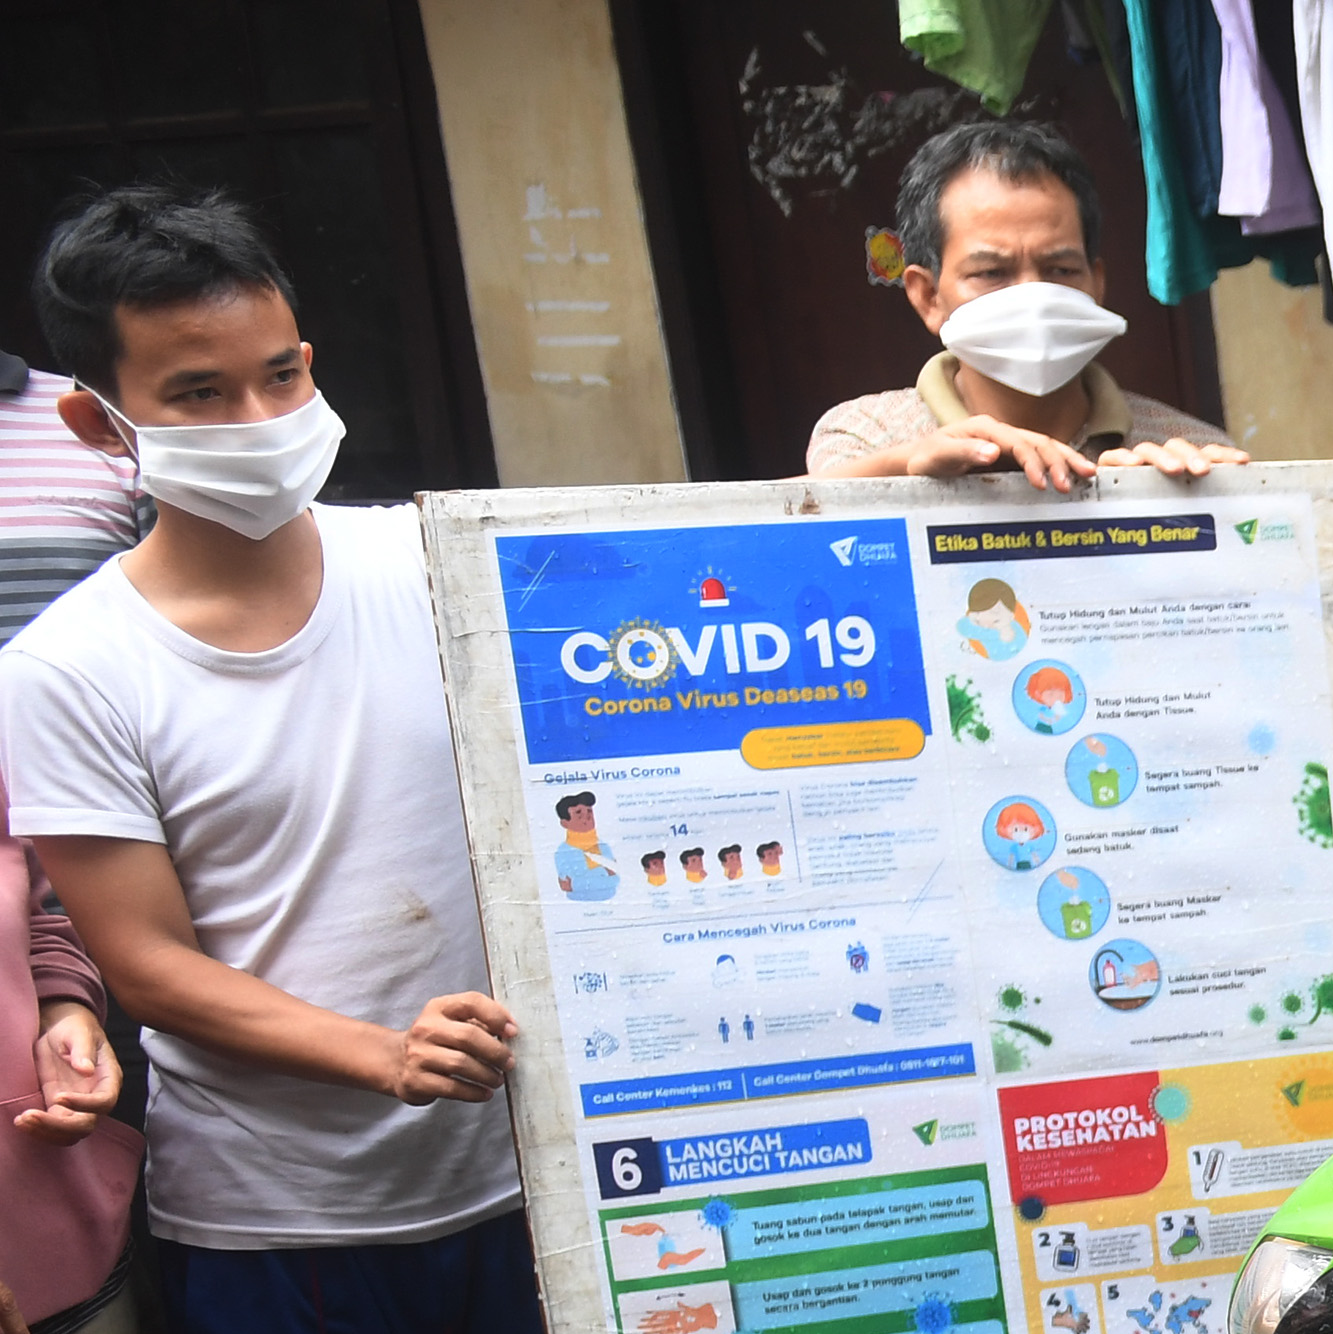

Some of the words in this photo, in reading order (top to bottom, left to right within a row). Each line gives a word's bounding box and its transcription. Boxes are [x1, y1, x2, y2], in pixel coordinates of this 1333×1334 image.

[935, 533, 978, 552] Etika
[983, 531, 1030, 549] Batuk
[1036, 532, 1047, 547] &
[1051, 529, 1103, 547] Bersin
[1108, 528, 1147, 546] Yang
[1151, 525, 1198, 542] Benar
[1040, 609, 1066, 620] Tutup
[1069, 608, 1105, 620] Hidung
[1109, 607, 1126, 615] dan
[1129, 605, 1157, 614] Mulut
[1162, 604, 1186, 613] Anda
[1190, 602, 1224, 613] dengan
[560, 622, 790, 684] COVID
[805, 615, 876, 668] 19
[584, 689, 672, 717] Corona
[678, 689, 739, 709] Virus
[744, 685, 839, 706] Deaseas
[843, 680, 867, 700] 19
[1095, 697, 1121, 707] Tutup
[1125, 695, 1158, 706] Hidung
[1162, 694, 1180, 702] dan
[1184, 692, 1211, 701] Mulut
[1096, 711, 1120, 720] Anda
[1124, 709, 1160, 720] dengan
[589, 769, 628, 782] Virus
[631, 764, 681, 778] Corona
[1144, 770, 1179, 781] Segera
[1182, 768, 1212, 778] buang
[1247, 763, 1259, 772] ke
[1146, 782, 1180, 793] tempat
[670, 824, 689, 837] 14
[1064, 832, 1108, 842] Gunakan
[1112, 827, 1146, 838] masker
[1150, 825, 1179, 834] disaat
[1066, 844, 1101, 855] sedang
[1117, 901, 1151, 912] Segera
[1154, 898, 1184, 908] buang
[1118, 916, 1130, 924] ke
[1133, 912, 1166, 923] tempat
[663, 931, 695, 944] Cara
[698, 924, 767, 943] Mencegah
[771, 921, 805, 934] Virus
[809, 917, 856, 929] Corona
[1168, 972, 1208, 983] Lakukan
[1212, 970, 1232, 979] cuci
[1234, 966, 1266, 977] tangan
[754, 1074, 774, 1087] Call
[777, 1071, 812, 1085] Center
[593, 1092, 614, 1104] Call
[616, 1089, 653, 1102] Center
[1014, 1104, 1143, 1135] PROTOKOL
[1017, 1120, 1157, 1152] KESEHATAN
[612, 1148, 643, 1191] 6
[665, 1132, 783, 1164] LANGKAH
[668, 1158, 771, 1182] MENCUCI
[775, 1143, 863, 1168] TANGAN
[1193, 1151, 1201, 1165] 1
[752, 1220, 784, 1232] Tuang
[786, 1214, 817, 1228] sabun
[819, 1212, 847, 1226] pada
[849, 1206, 886, 1222] telapak
[887, 1202, 927, 1217] tangan,
[929, 1199, 955, 1212] usap
[955, 1195, 975, 1206] dan
[753, 1232, 785, 1246] gosok
[787, 1230, 800, 1241] ke
[803, 1228, 823, 1239] dua
[826, 1223, 861, 1238] tangan
[864, 1219, 901, 1235] dengan
[903, 1215, 927, 1228] arah
[1162, 1217, 1174, 1231] 3
[1038, 1232, 1051, 1247] 2
[763, 1290, 789, 1303] Usap
[792, 1287, 812, 1299] dan
[815, 1283, 844, 1297] gosok
[861, 1280, 869, 1290] 2
[871, 1275, 921, 1292] punggung
[924, 1267, 960, 1282] tangan
[1047, 1293, 1061, 1307] 4
[1107, 1285, 1119, 1300] 5
